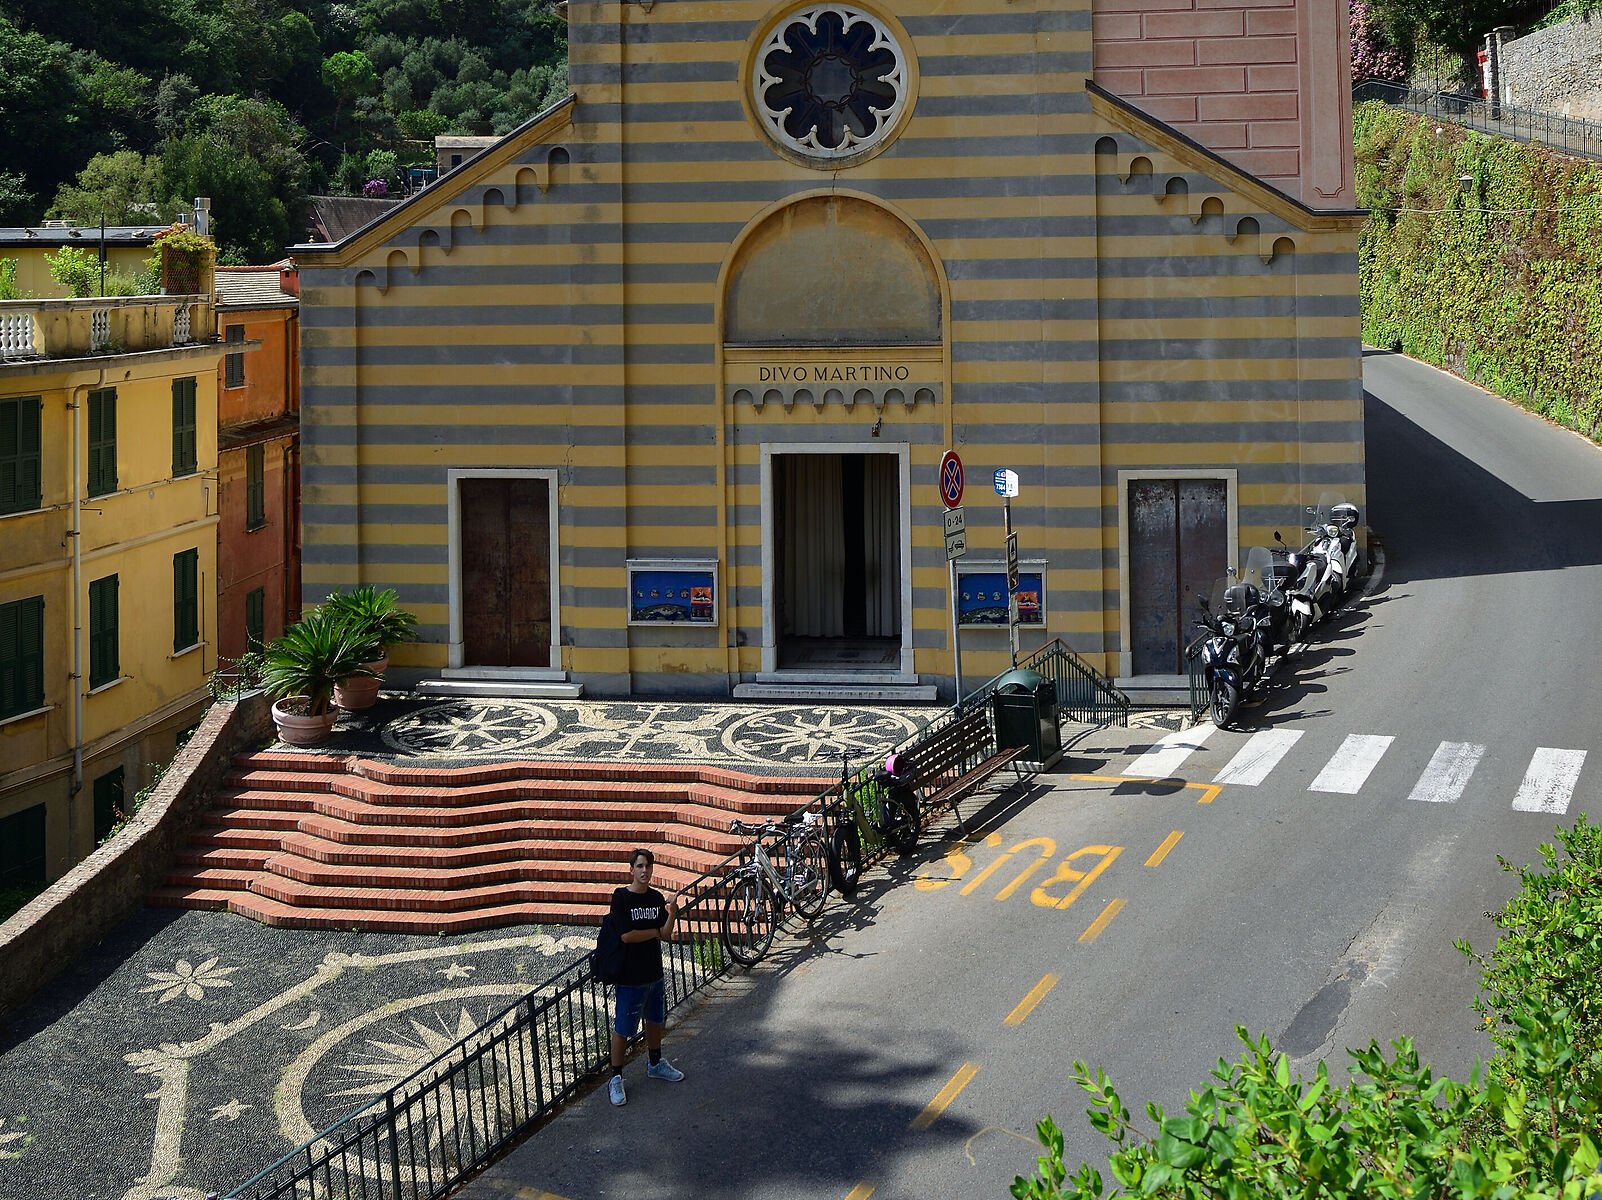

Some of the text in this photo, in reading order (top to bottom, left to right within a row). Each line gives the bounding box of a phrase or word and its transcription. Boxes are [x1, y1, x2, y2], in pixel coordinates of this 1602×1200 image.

[759, 365, 910, 382] DIVO MARTINO
[914, 831, 1126, 910] BUS
